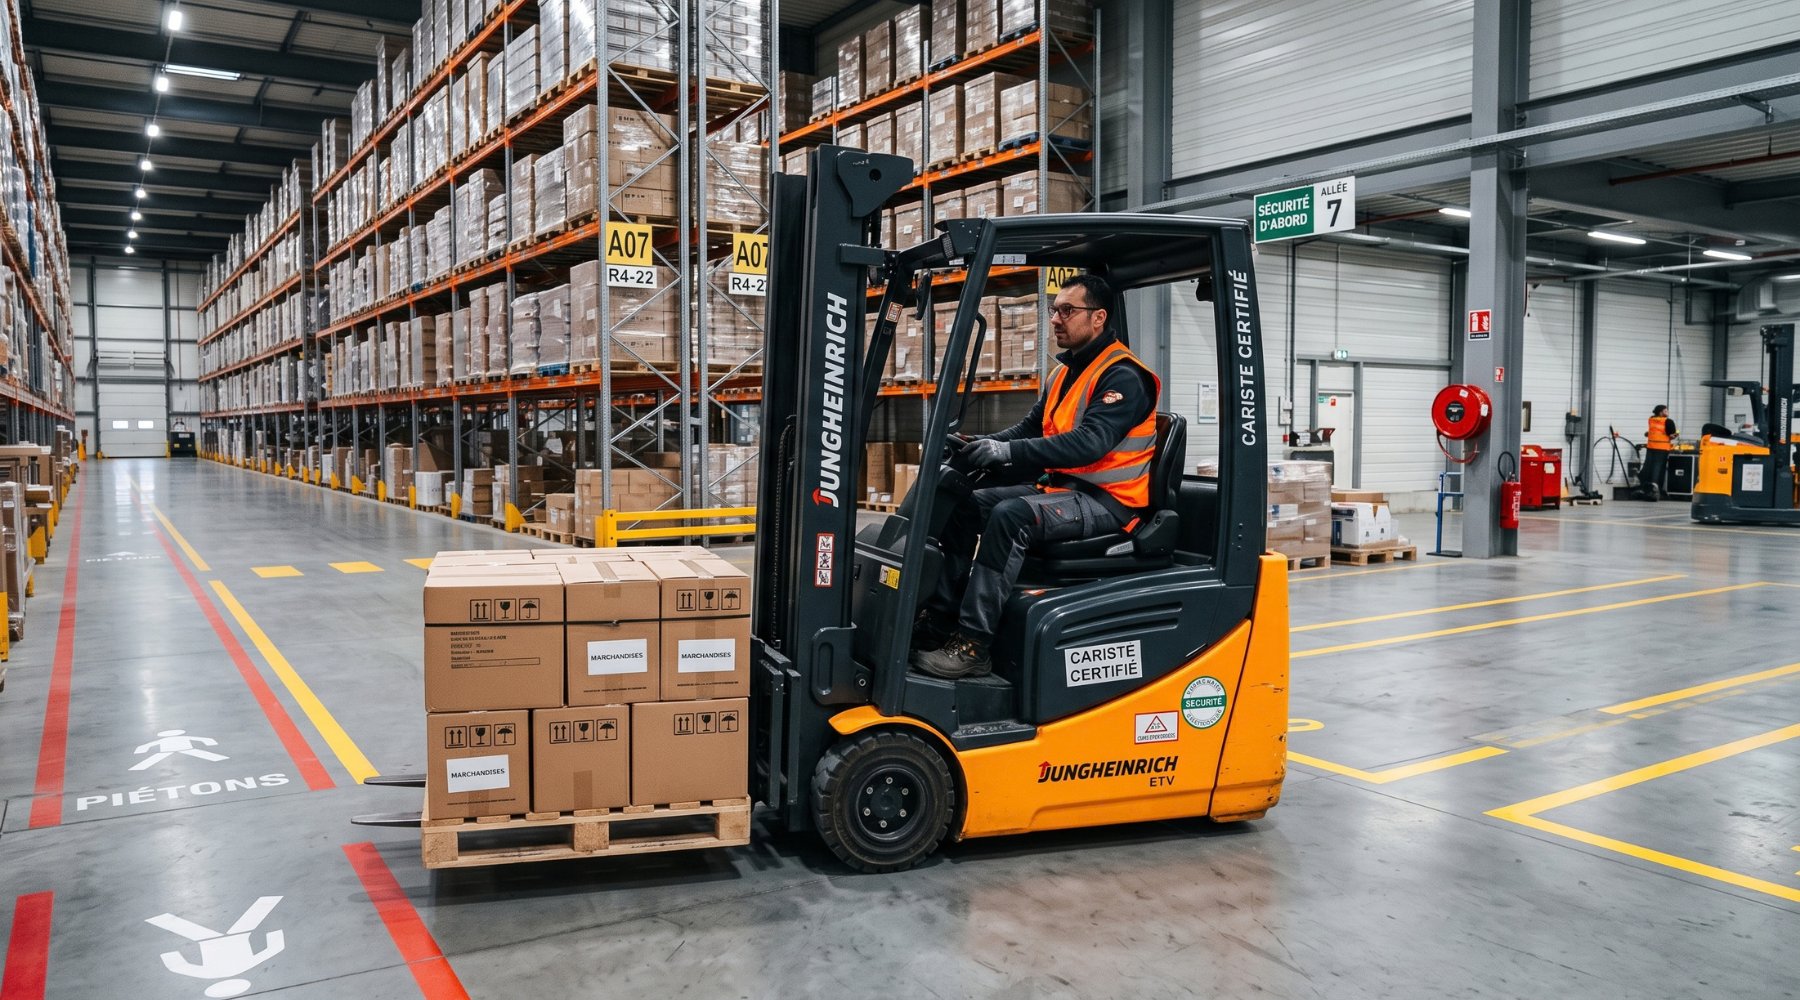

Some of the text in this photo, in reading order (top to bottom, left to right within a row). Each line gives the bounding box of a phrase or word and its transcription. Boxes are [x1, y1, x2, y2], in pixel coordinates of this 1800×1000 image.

[1321, 181, 1348, 197] ALLÉE
[1258, 193, 1310, 217] SÉCURITÉ
[1327, 198, 1342, 227] 7
[1259, 212, 1308, 232] D'ABORD
[608, 229, 649, 259] A07
[609, 268, 654, 285] R4-22
[732, 277, 767, 292] R4-2
[1228, 269, 1257, 447] CARISTE CERTIFIÉ
[813, 291, 848, 509] JUNGHEINRICH
[590, 652, 644, 661] MARCHANDISES
[681, 651, 732, 660] MARCHANDISES
[1070, 659, 1138, 682] CERTIFIÉ
[451, 767, 505, 779] MARCHANDISES
[1037, 755, 1179, 784] JUNGHEINRICH
[76, 772, 290, 811] PIÉTONS
[1149, 775, 1175, 788] ETV
